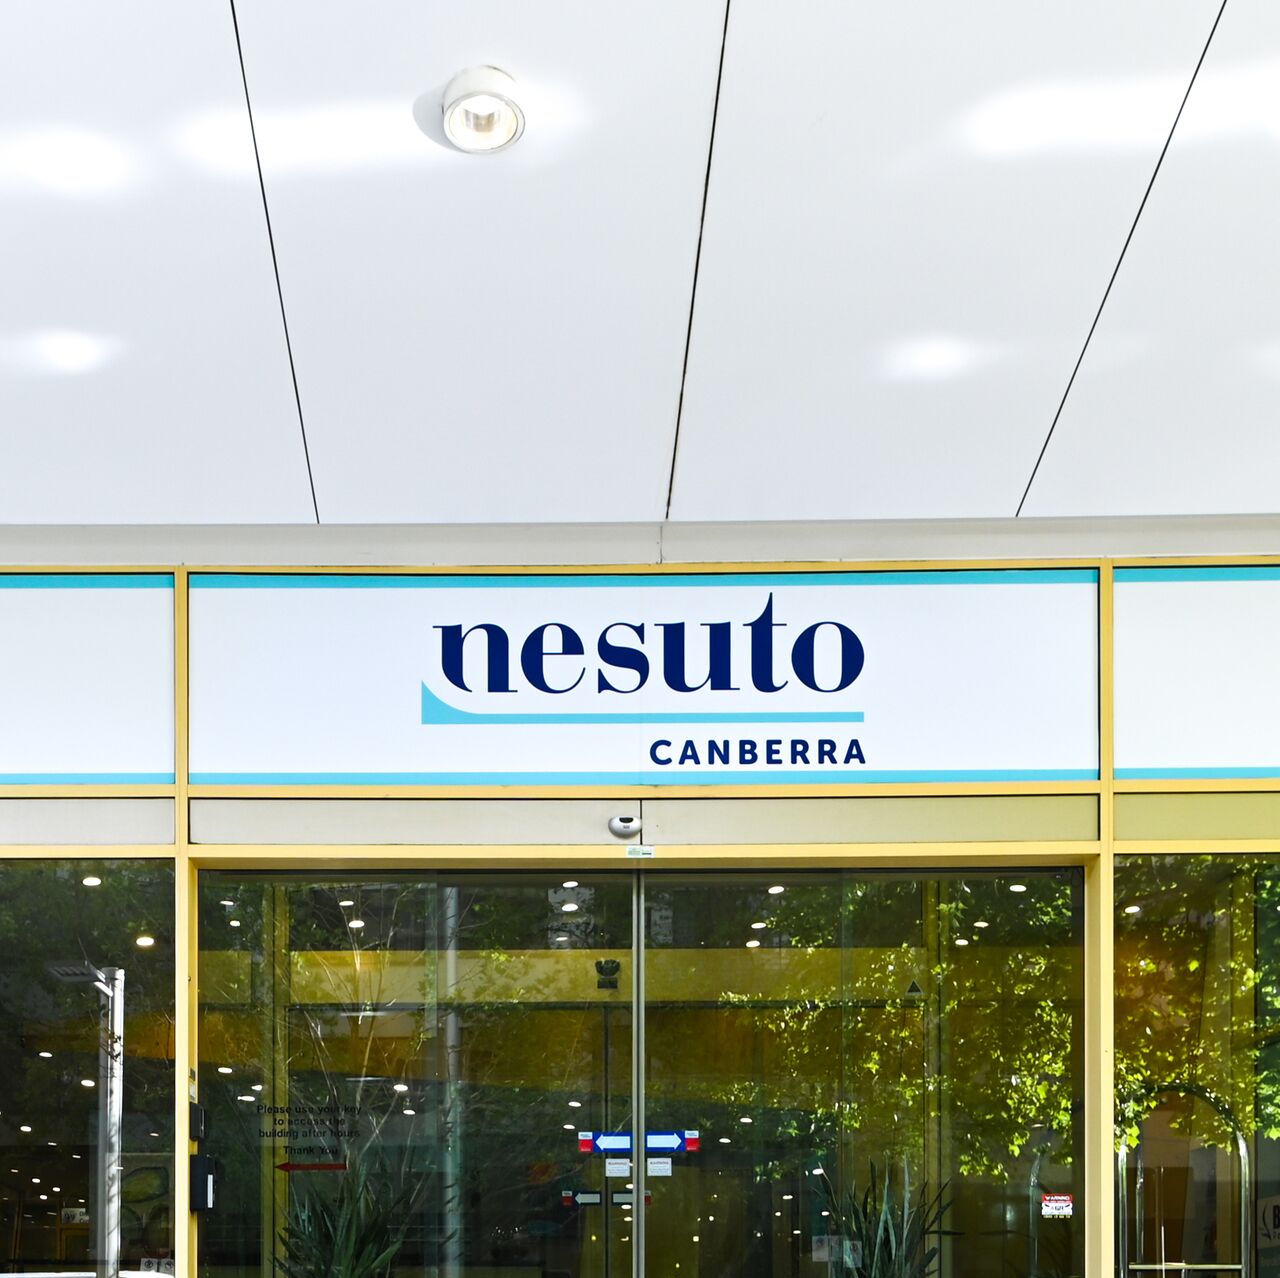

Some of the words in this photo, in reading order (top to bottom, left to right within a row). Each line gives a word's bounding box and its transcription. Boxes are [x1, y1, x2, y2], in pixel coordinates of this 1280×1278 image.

[432, 591, 865, 694] nesuto
[649, 739, 867, 765] CANBERRA
[256, 1104, 291, 1114] Please
[295, 1105, 313, 1114] use
[316, 1106, 339, 1116] your
[344, 1104, 362, 1116] key
[273, 1117, 285, 1126] to
[288, 1118, 321, 1126] access
[258, 1128, 298, 1140] building
[301, 1128, 327, 1138] after
[330, 1128, 361, 1138] hours
[282, 1145, 316, 1155] Thank
[319, 1145, 339, 1155] You
